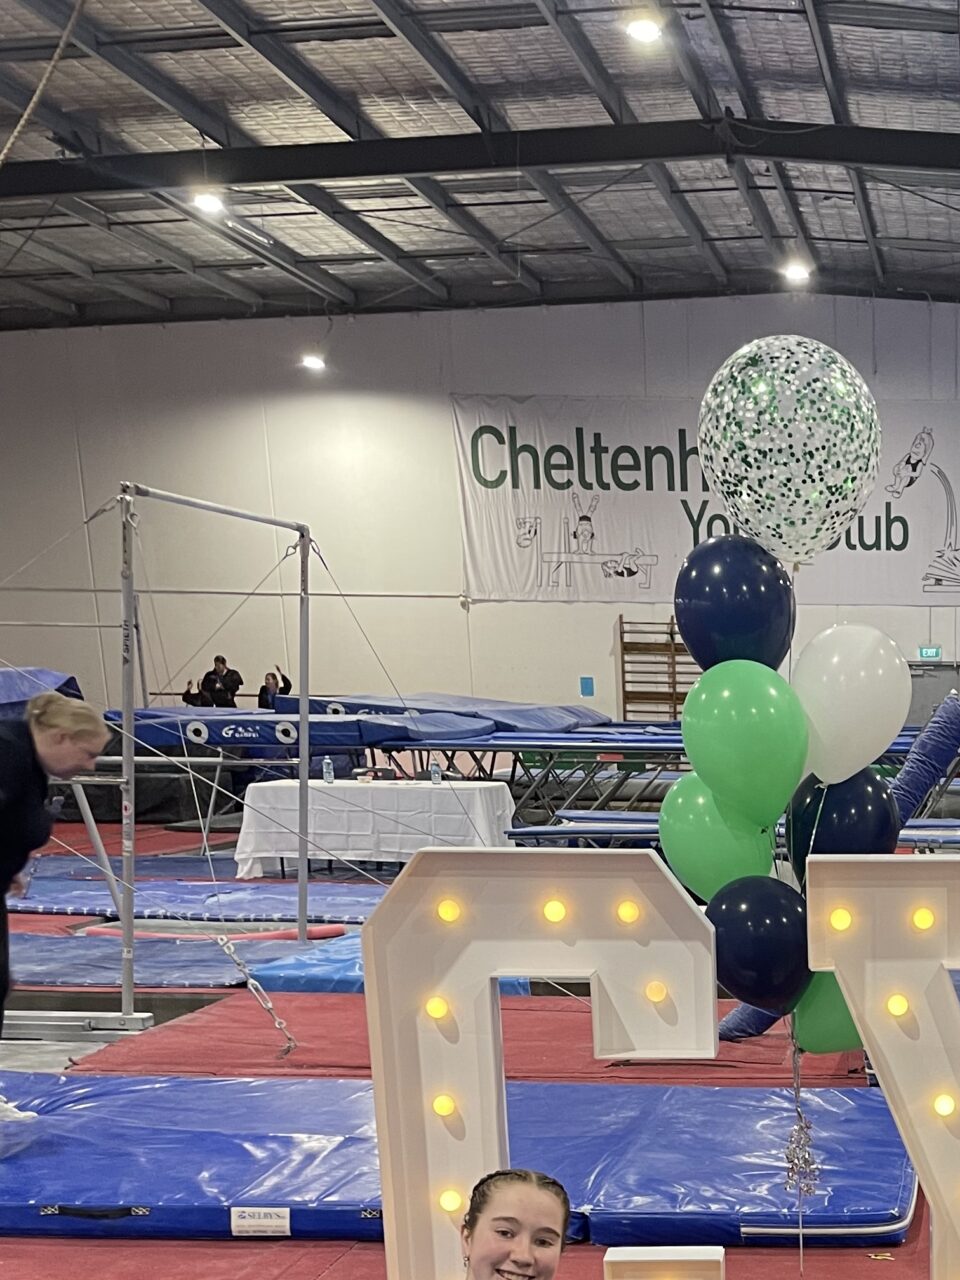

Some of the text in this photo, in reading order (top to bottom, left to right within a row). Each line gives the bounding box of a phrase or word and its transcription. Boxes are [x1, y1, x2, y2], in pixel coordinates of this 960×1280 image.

[471, 425, 710, 492] Cheltenh
[825, 502, 910, 551] lub
[922, 648, 937, 657] EXIT
